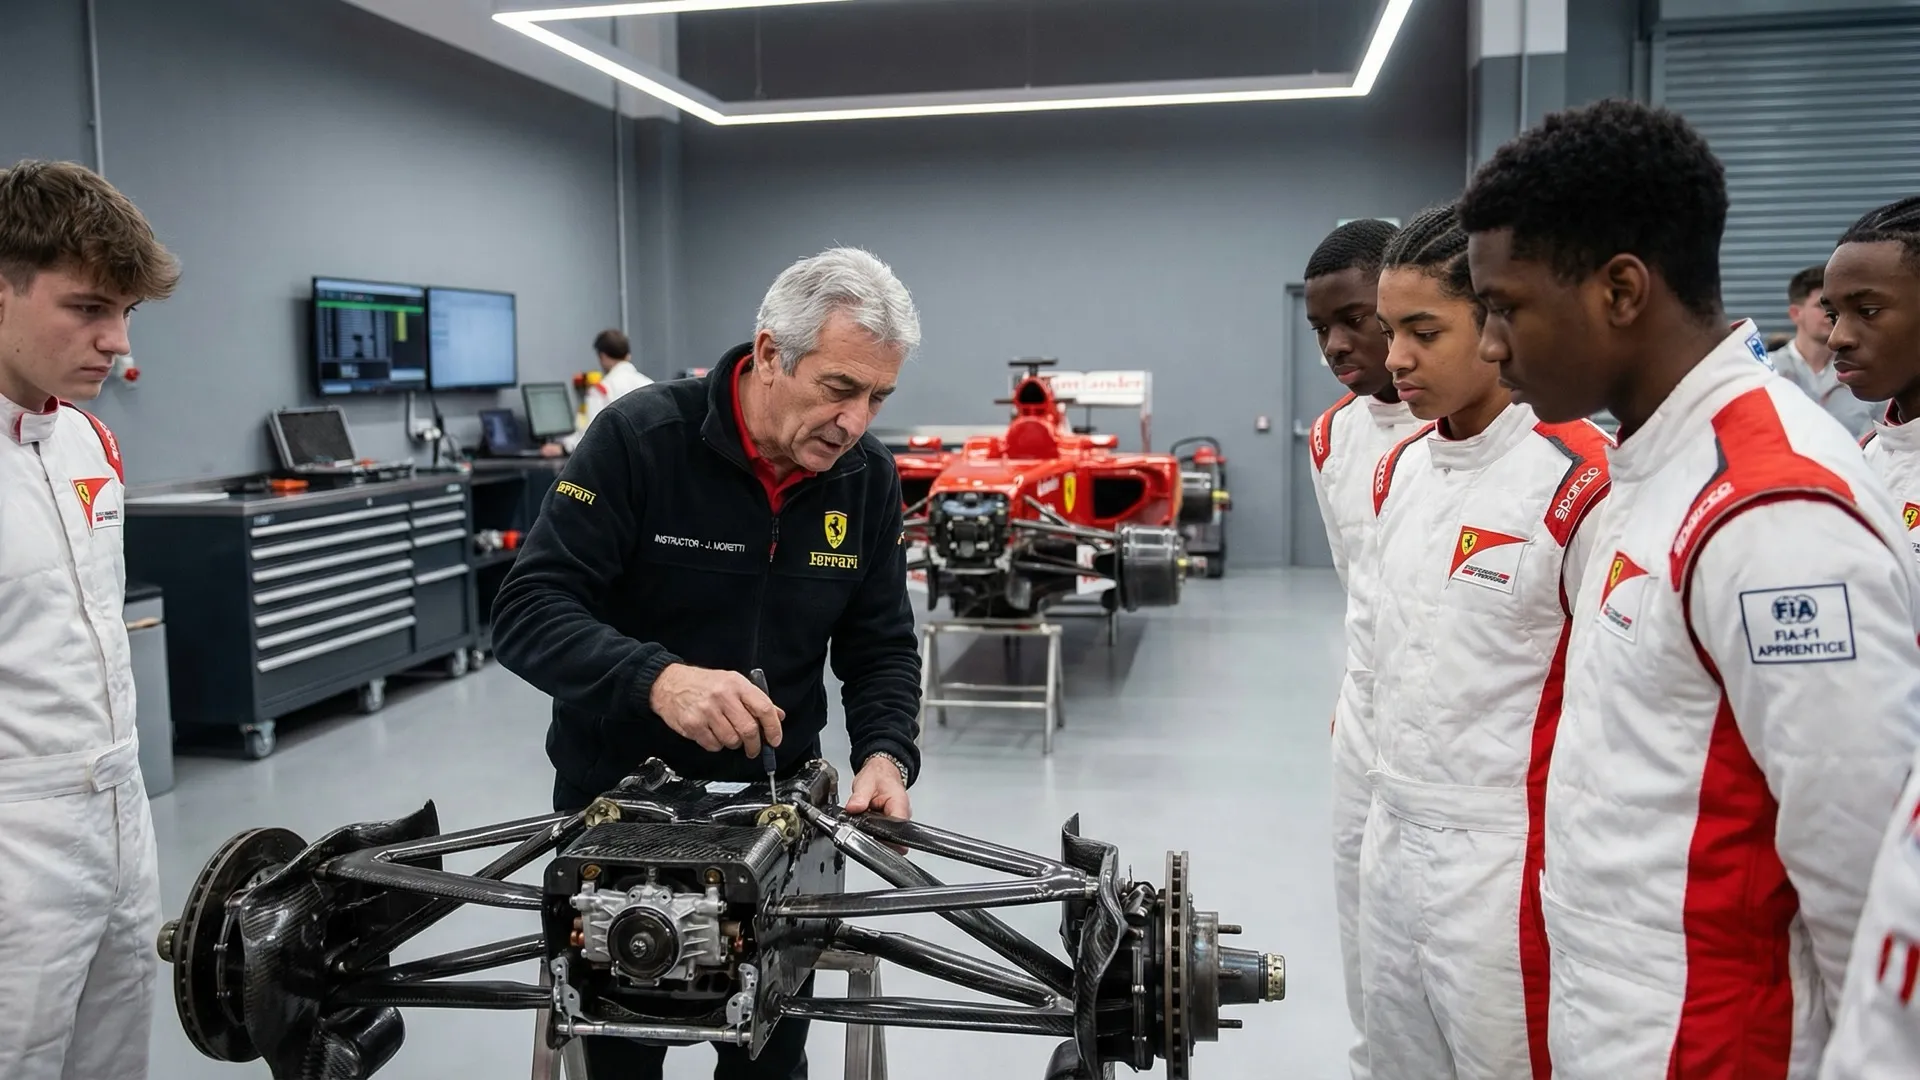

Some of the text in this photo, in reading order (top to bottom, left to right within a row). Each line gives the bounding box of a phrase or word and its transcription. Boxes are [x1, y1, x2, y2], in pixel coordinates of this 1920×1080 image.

[1555, 467, 1601, 522] sparco
[654, 534, 700, 548] INSTRUCTOR
[705, 540, 713, 550] J.
[809, 552, 858, 569] Ferrari
[1774, 628, 1820, 641] FIA-F1
[1758, 641, 1848, 657] APPRENTICE
